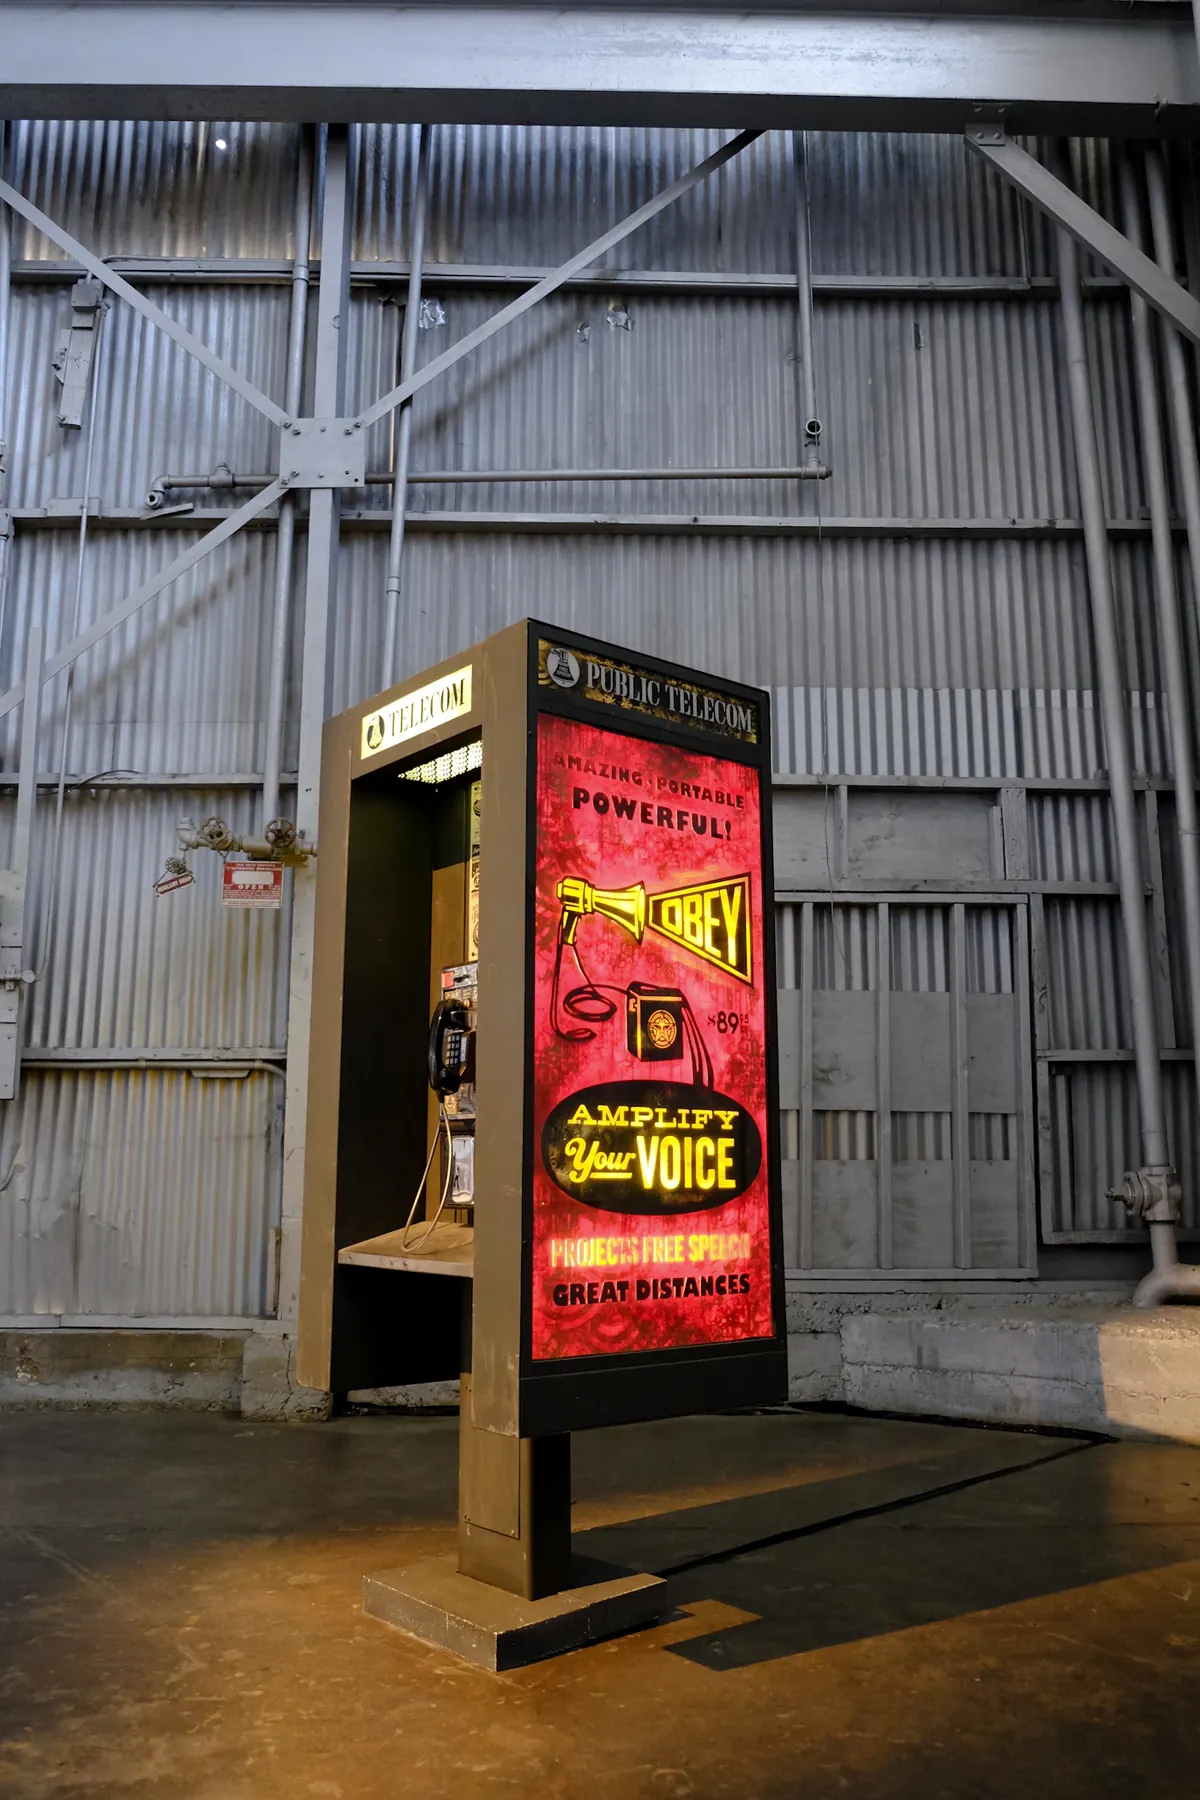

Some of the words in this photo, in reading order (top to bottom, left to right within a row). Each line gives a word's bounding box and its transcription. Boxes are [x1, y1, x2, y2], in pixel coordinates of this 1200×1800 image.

[389, 678, 465, 737] TELECOM
[587, 661, 661, 707] PUBLIC
[665, 684, 752, 733] TELECOM
[554, 752, 643, 786] AMAZING
[656, 777, 745, 810] PORTABLE
[572, 786, 732, 841] POWERFUL!
[661, 885, 742, 967] OBEY
[567, 1104, 740, 1130] AMPLIFY
[565, 1137, 637, 1183] Your
[636, 1135, 737, 1190] VOICE
[551, 1237, 638, 1268] PROJECTS
[643, 1235, 685, 1264] FREE
[688, 1233, 751, 1262] SPEECH
[552, 1280, 630, 1307] GREAT
[636, 1273, 751, 1301] DISTANCES
